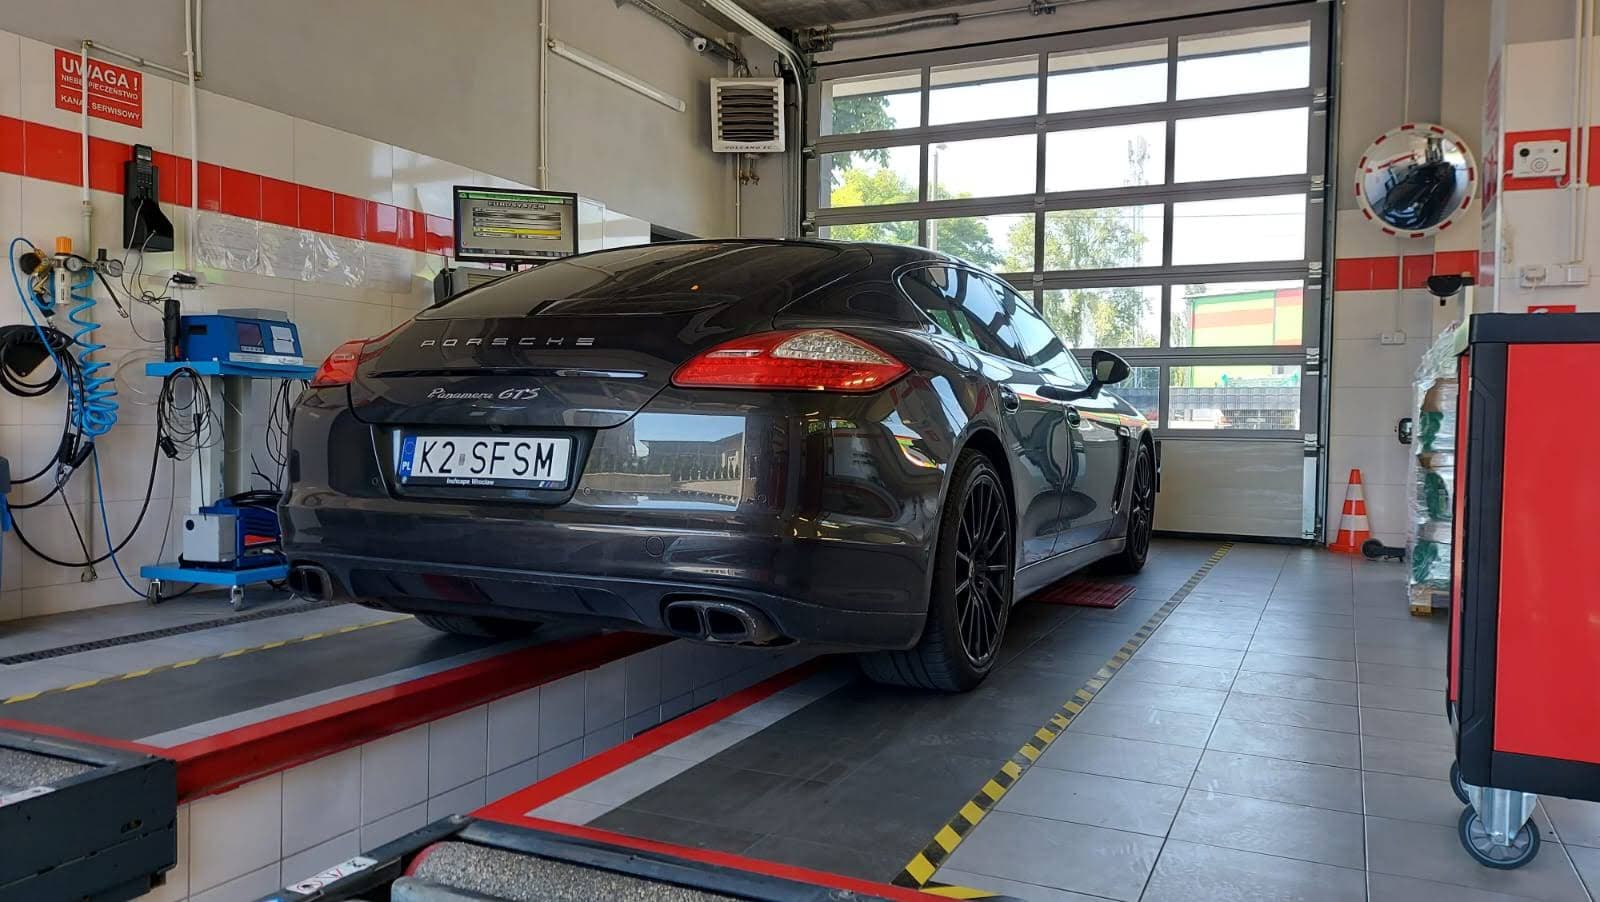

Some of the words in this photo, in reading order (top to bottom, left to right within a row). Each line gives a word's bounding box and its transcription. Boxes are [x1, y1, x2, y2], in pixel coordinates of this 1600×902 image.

[61, 56, 130, 89] UWAGA
[61, 94, 90, 109] KANA
[91, 102, 140, 120] SERWISOWY
[420, 337, 595, 347] PORSCHE
[427, 387, 494, 399] Panamera
[498, 387, 541, 400] GTS
[402, 461, 411, 471] PL
[419, 440, 456, 474] K2
[470, 441, 555, 477] SFSM
